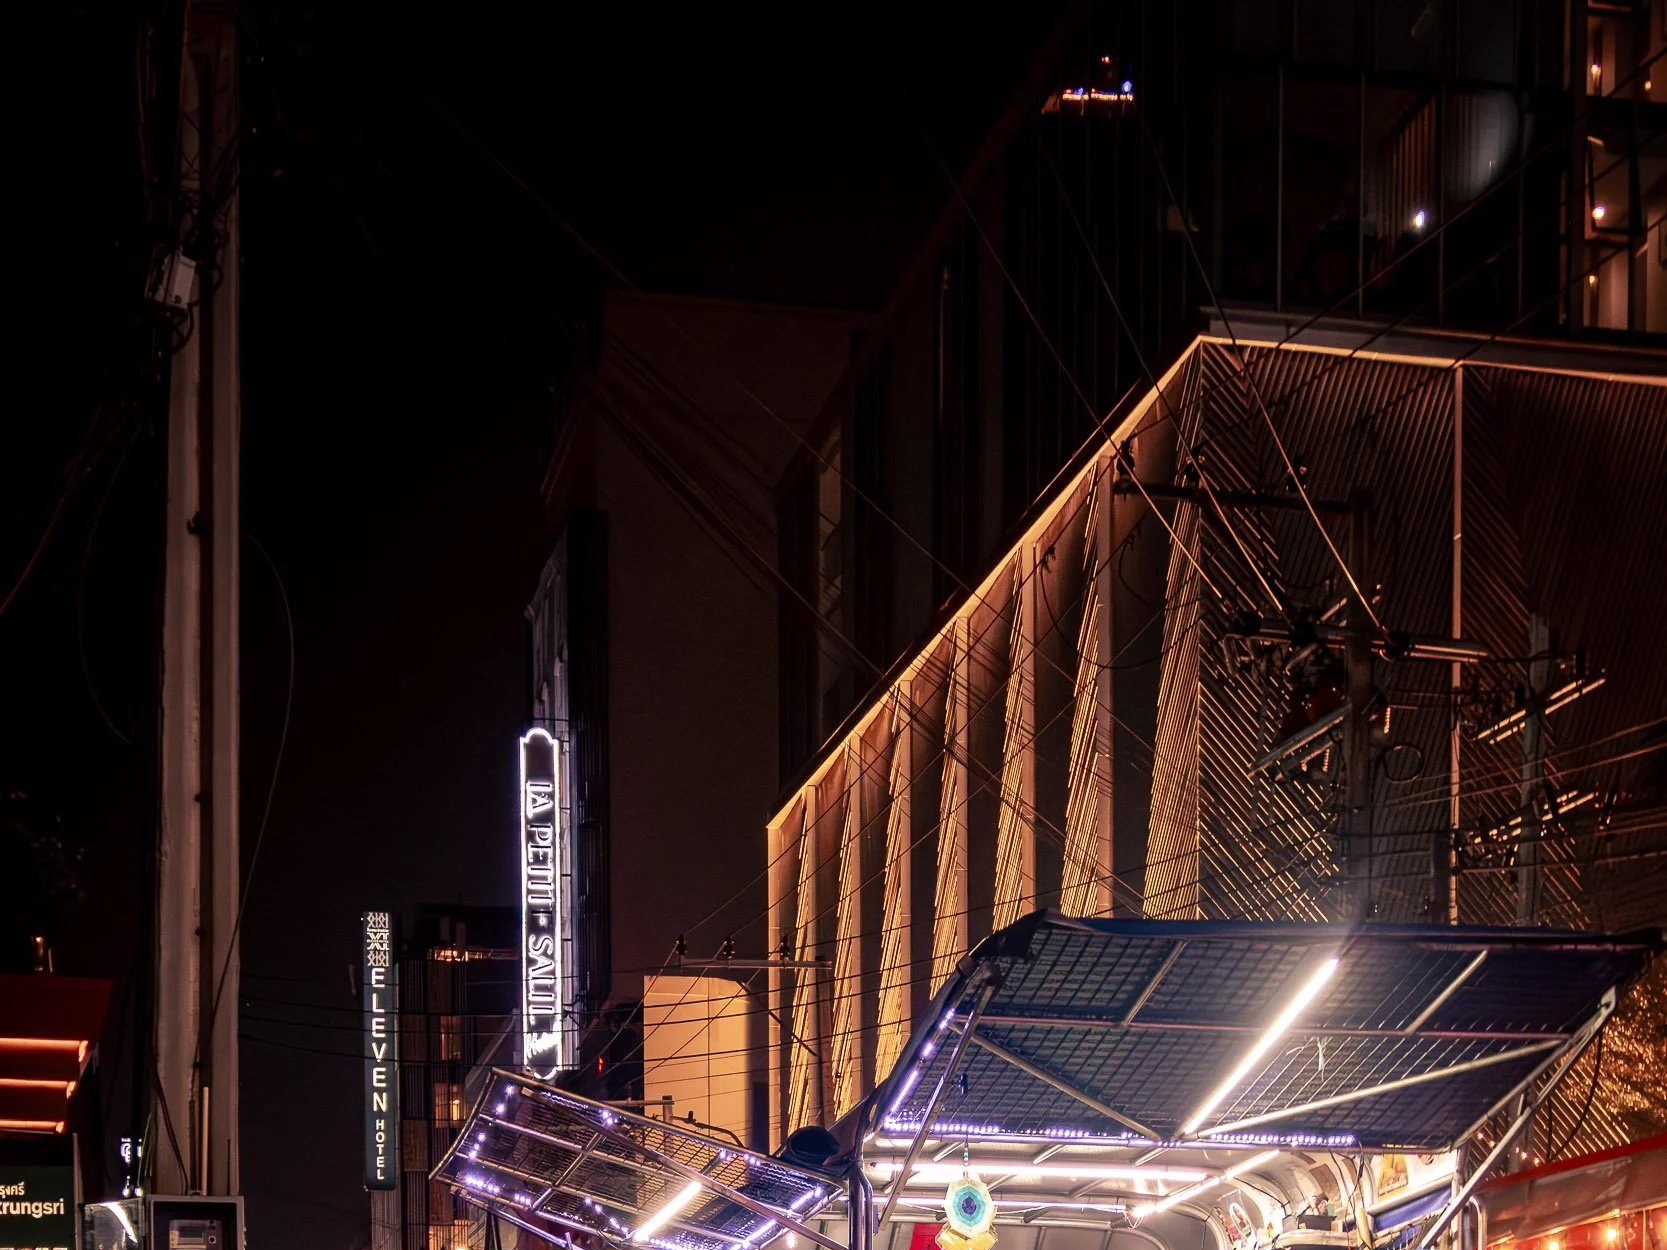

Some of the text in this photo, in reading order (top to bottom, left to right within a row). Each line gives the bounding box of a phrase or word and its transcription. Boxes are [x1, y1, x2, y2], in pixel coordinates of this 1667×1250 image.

[528, 934, 555, 1025] SALIL
[371, 967, 388, 1180] ELEVEN HOTEL
[0, 1198, 65, 1219] rungsri
